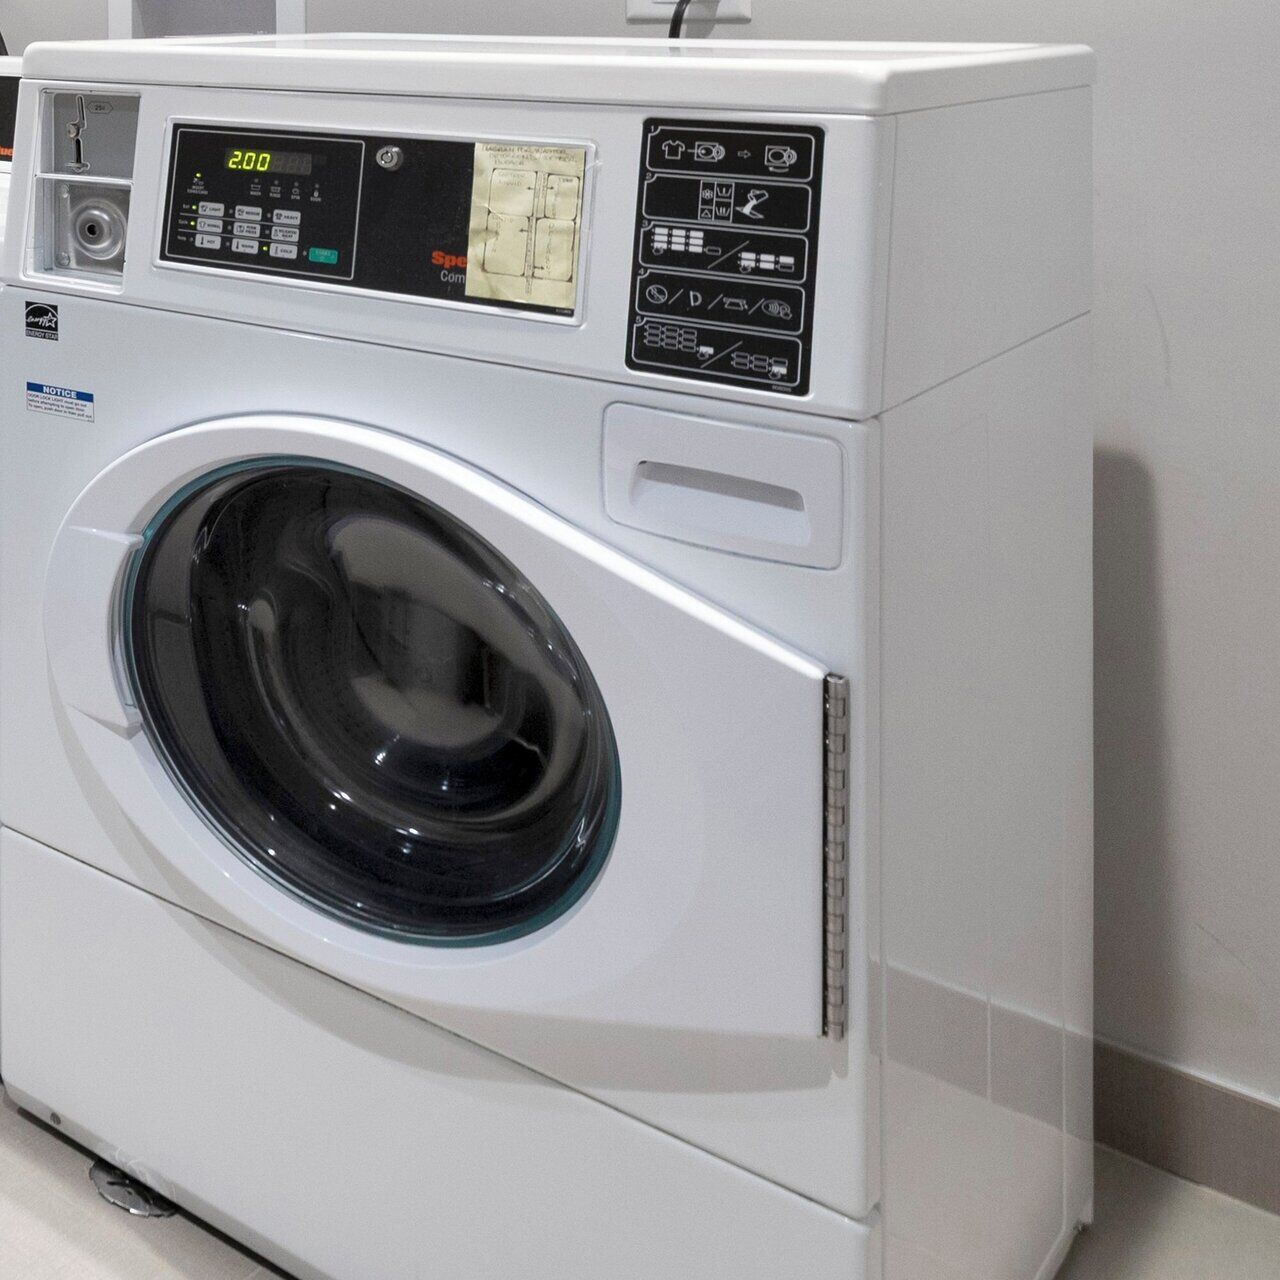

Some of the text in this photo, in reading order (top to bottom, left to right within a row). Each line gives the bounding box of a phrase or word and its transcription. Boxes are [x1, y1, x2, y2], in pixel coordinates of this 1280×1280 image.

[228, 150, 271, 171] 2.00
[432, 250, 468, 268] Spe
[440, 270, 466, 284] Com
[43, 386, 77, 398] NOTICE
